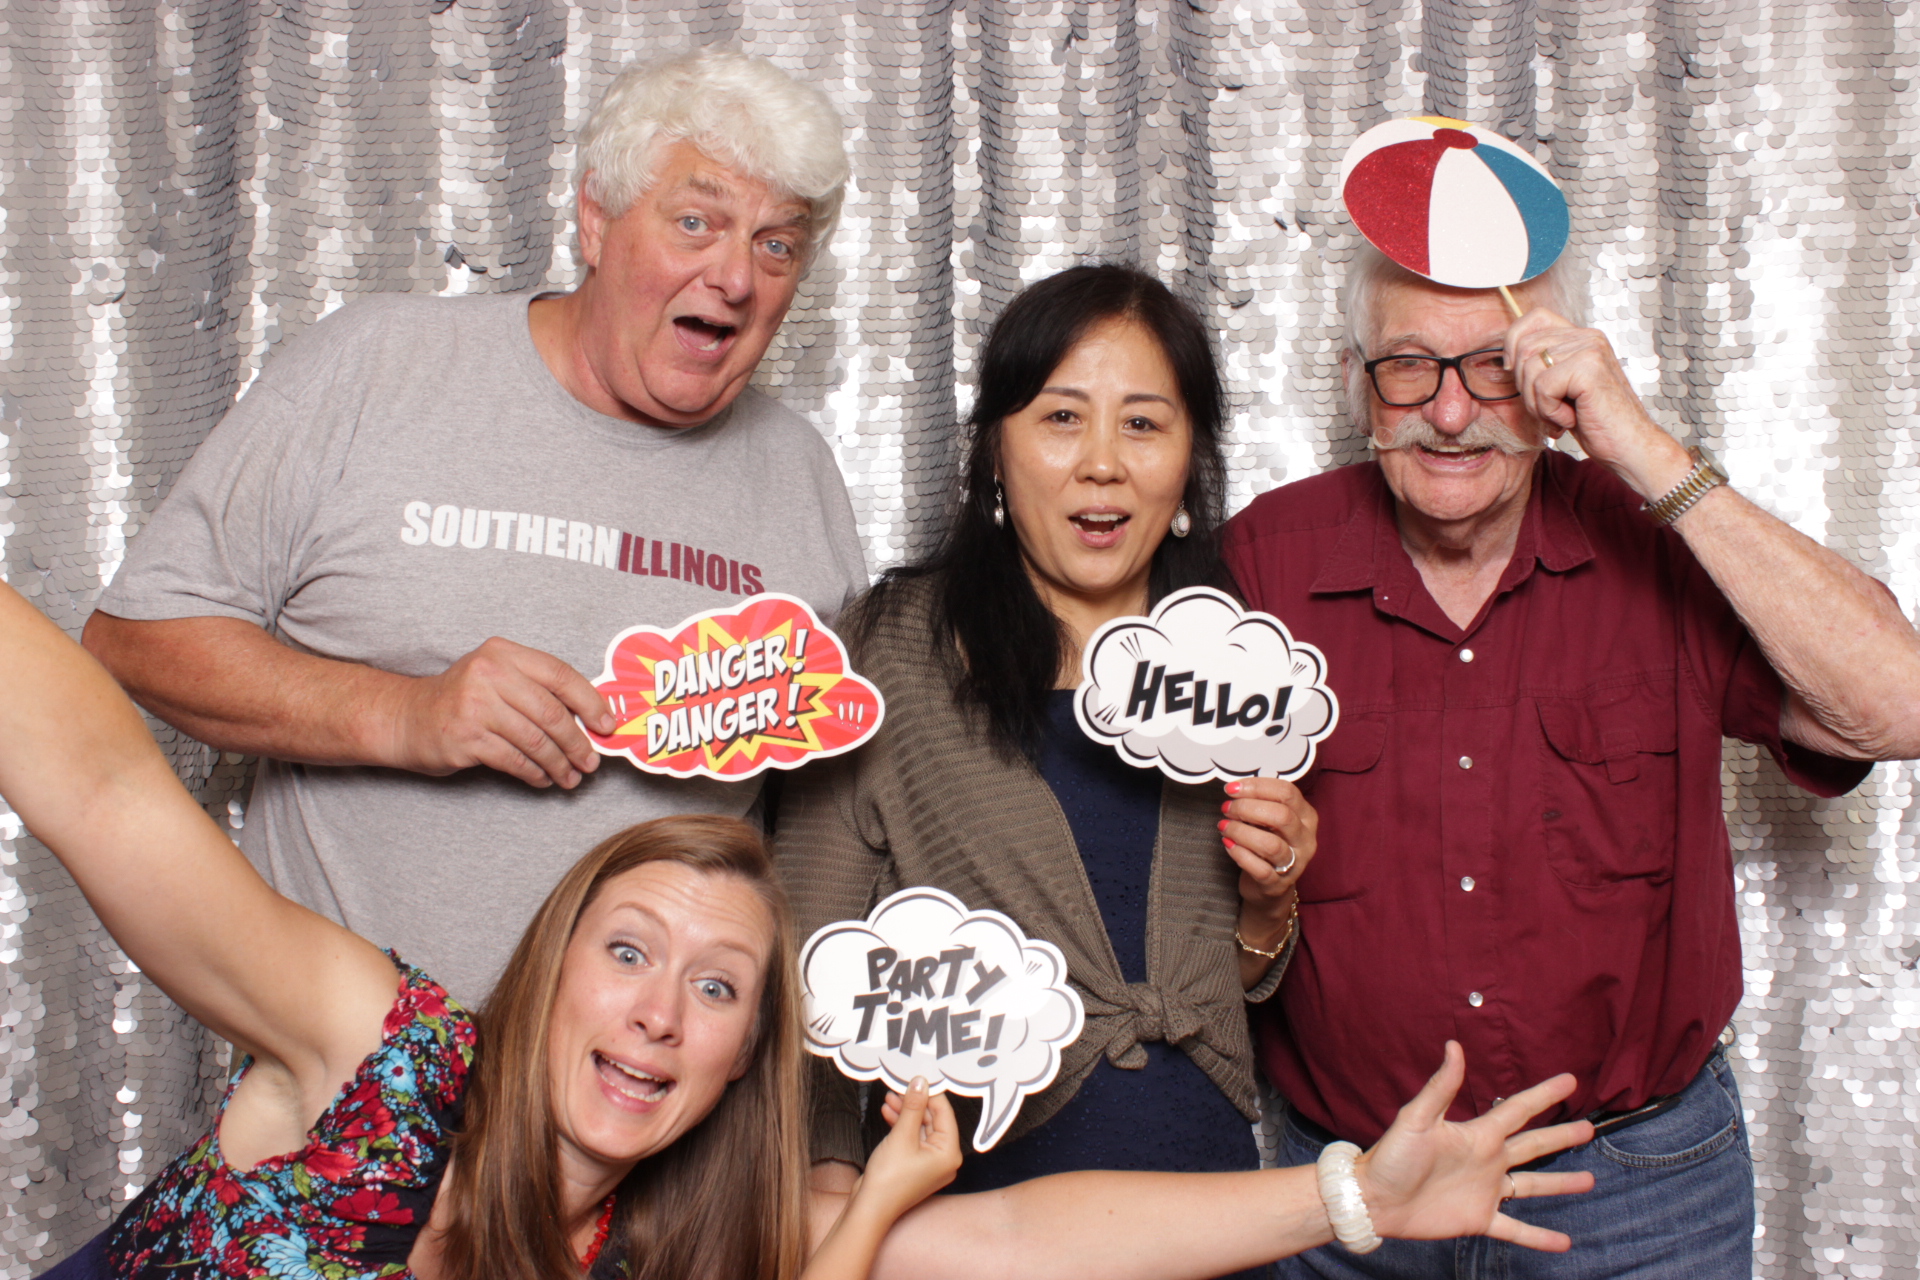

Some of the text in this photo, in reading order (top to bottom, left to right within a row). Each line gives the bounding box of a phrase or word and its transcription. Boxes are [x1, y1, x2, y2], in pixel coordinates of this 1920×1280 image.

[654, 628, 809, 705] DANGER!
[1124, 659, 1294, 737] HELLO!
[646, 682, 801, 757] DANGER!
[866, 946, 1007, 1006] PARTY
